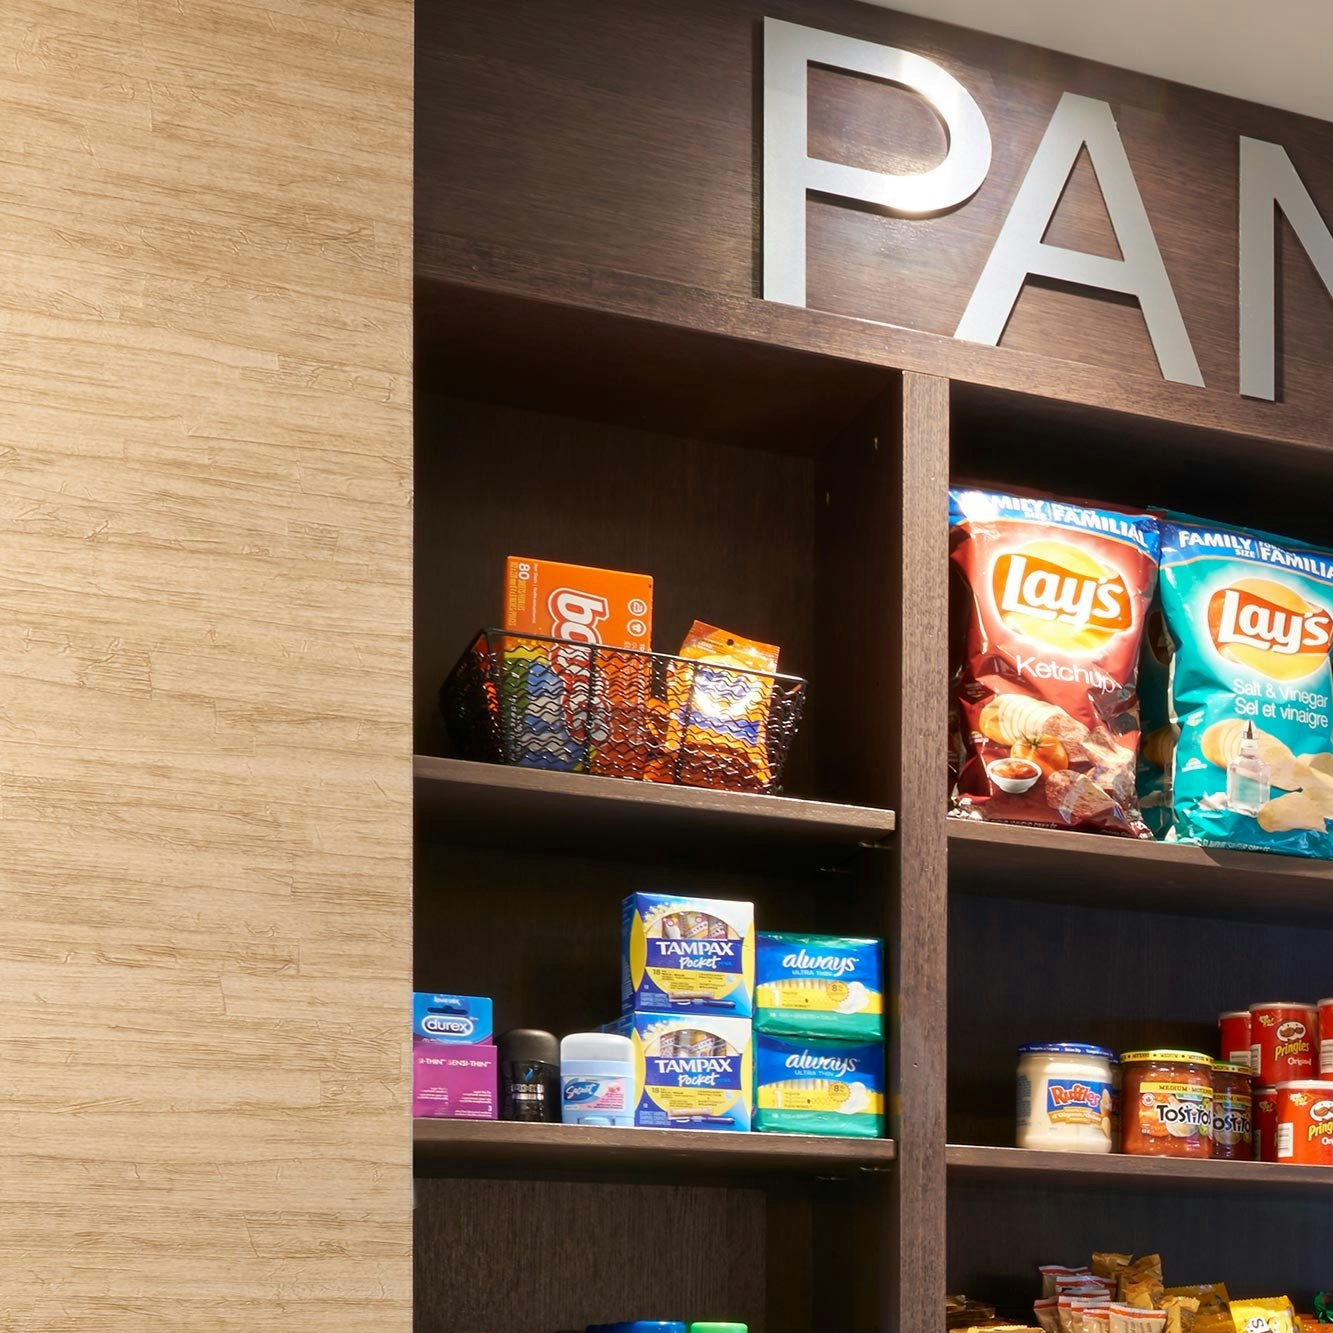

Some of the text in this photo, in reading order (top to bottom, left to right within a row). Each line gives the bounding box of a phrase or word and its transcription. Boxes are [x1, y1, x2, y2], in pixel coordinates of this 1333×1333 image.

[1053, 507, 1148, 548] FAMILIAL
[1179, 531, 1251, 550] FAMILY
[1235, 549, 1255, 559] SIZE
[998, 554, 1126, 627] Lay's
[1222, 590, 1333, 654] Lay's
[1015, 655, 1116, 695] Ketchup
[1233, 679, 1329, 709] Salt & Vinegar
[1234, 697, 1329, 729] Sel et vinaigre
[655, 940, 735, 957] TAMPAX
[782, 948, 859, 977] always
[425, 1018, 469, 1035] durex
[785, 1049, 860, 1078] always
[1274, 1040, 1310, 1062] Pringles
[654, 1058, 733, 1074] TAMPAX
[1049, 1083, 1101, 1107] Ruffles
[1158, 1084, 1188, 1092] MEDIUM
